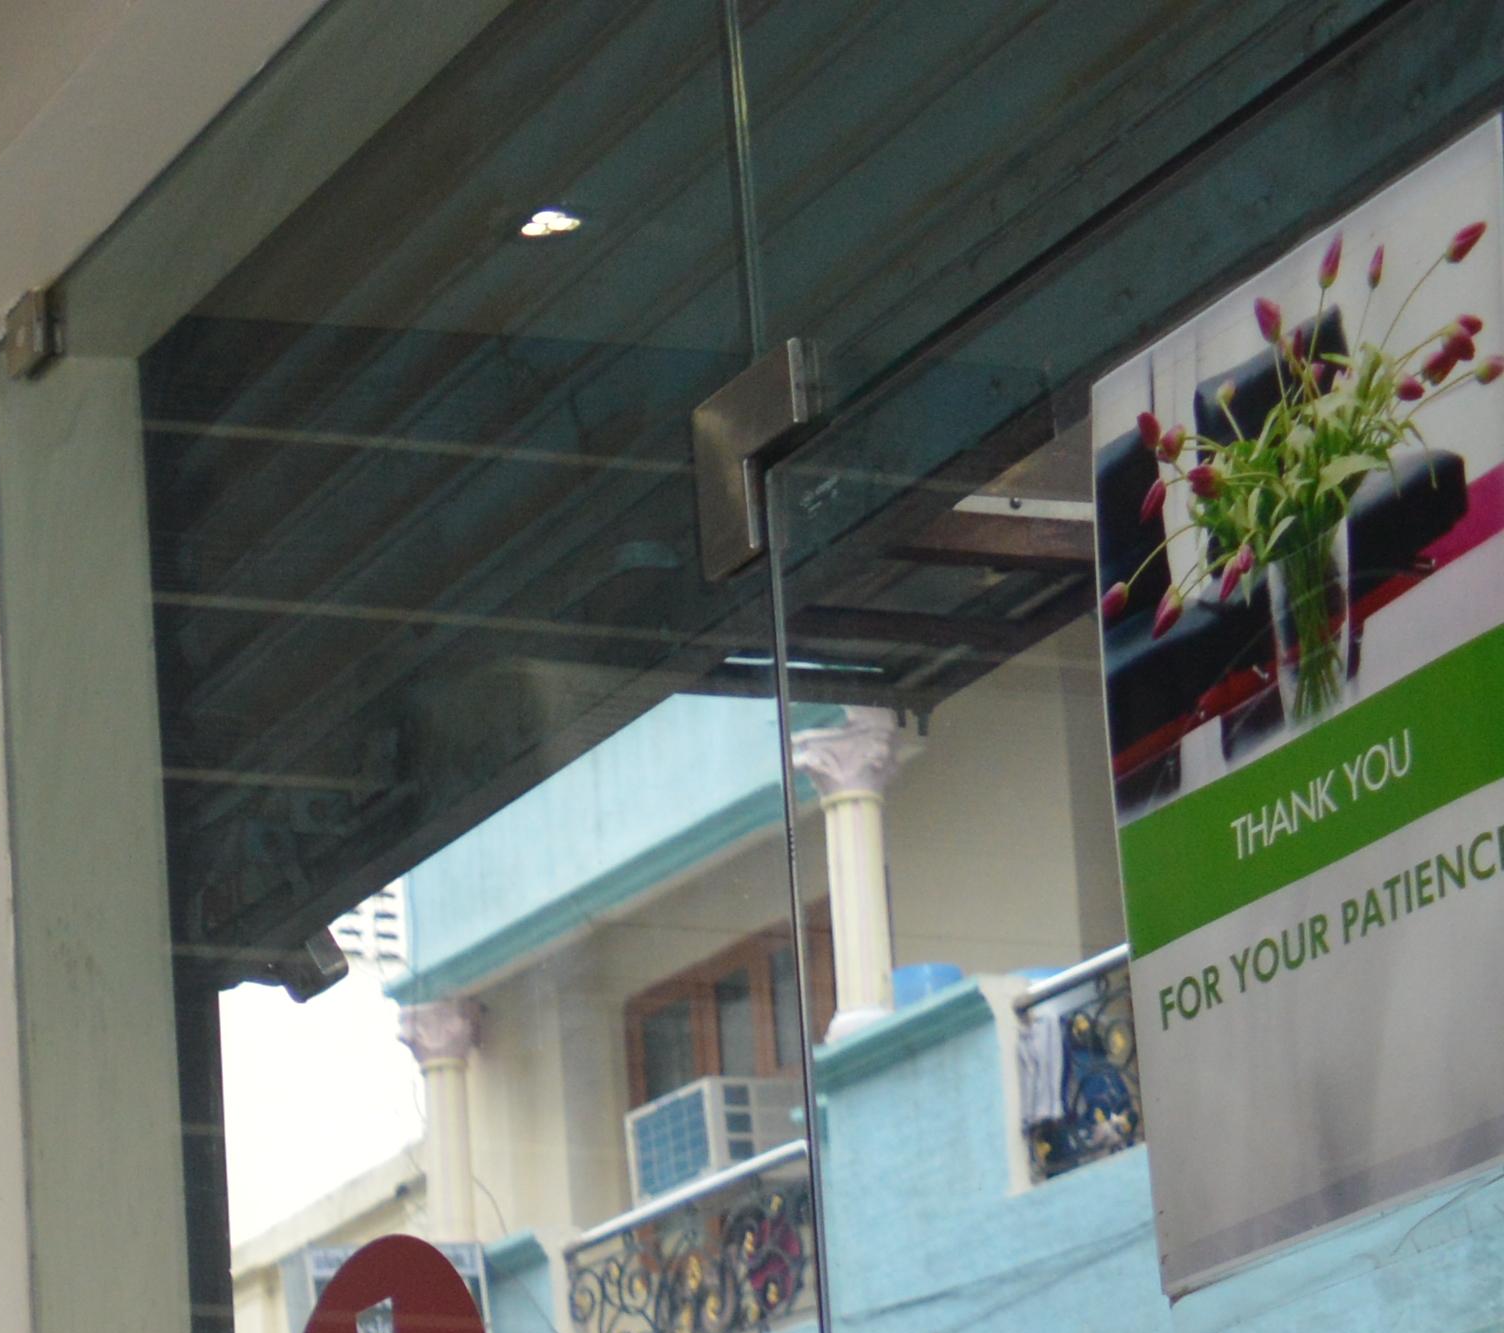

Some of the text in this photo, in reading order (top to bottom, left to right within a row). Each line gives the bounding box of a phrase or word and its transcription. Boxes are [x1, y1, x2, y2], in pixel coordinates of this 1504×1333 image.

[1231, 729, 1411, 860] THANK YOU
[1159, 965, 1223, 1031] FOR
[1230, 914, 1330, 993] YOUR
